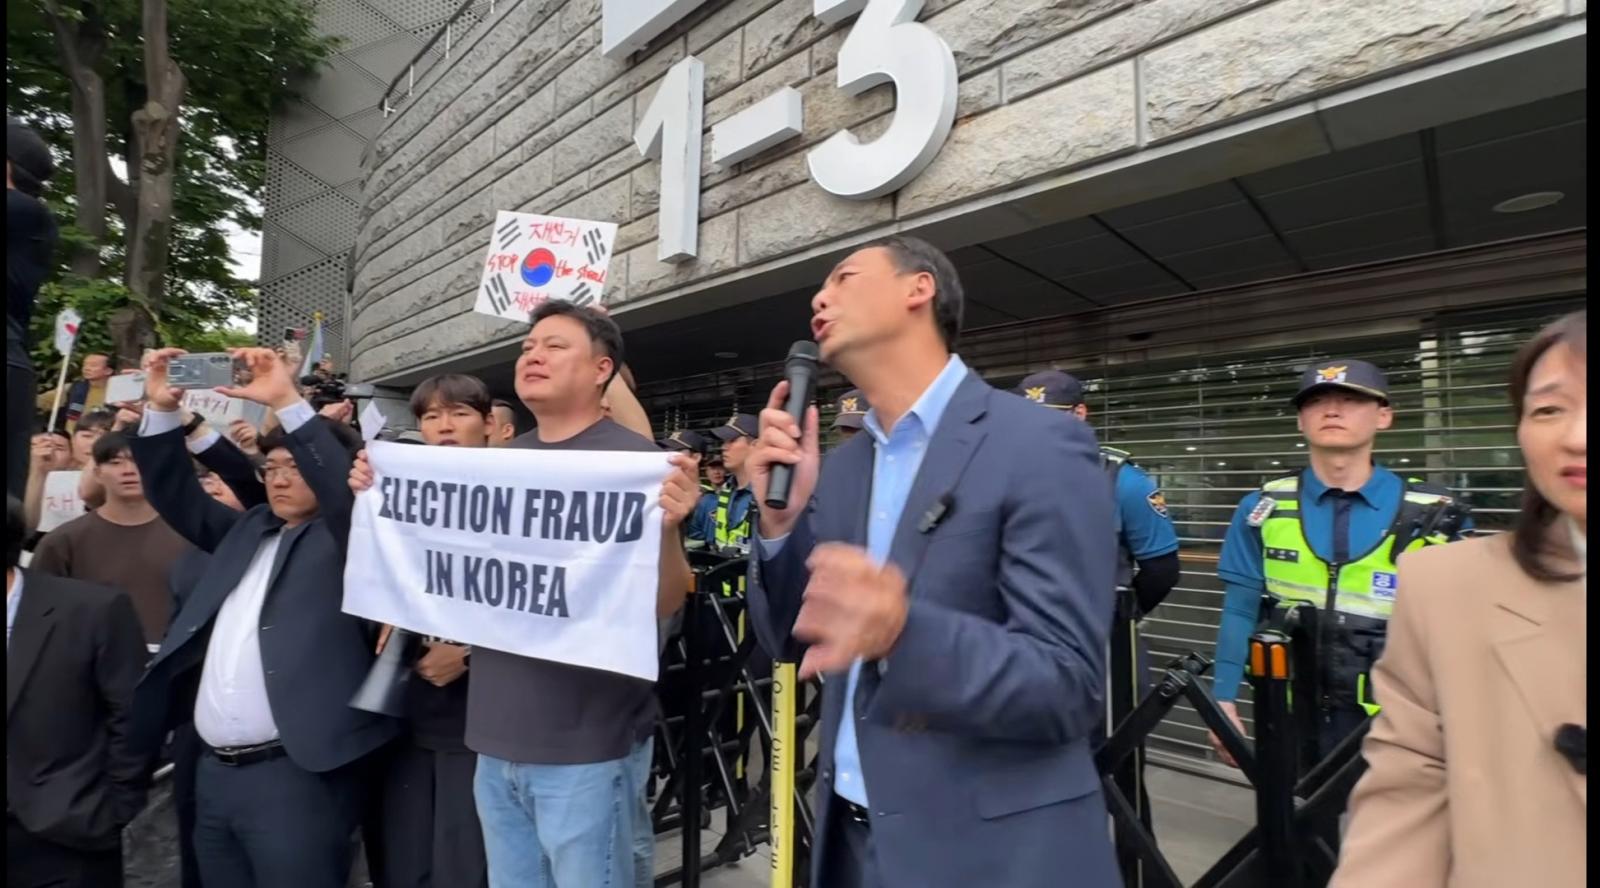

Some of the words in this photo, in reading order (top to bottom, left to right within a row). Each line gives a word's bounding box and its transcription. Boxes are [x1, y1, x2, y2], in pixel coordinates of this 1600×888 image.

[633, 0, 959, 263] 1-3
[488, 253, 519, 274] STOP
[378, 476, 515, 536] ELECTION
[522, 488, 647, 544] FRAUD
[424, 549, 454, 598] IN
[463, 555, 570, 618] KOREA
